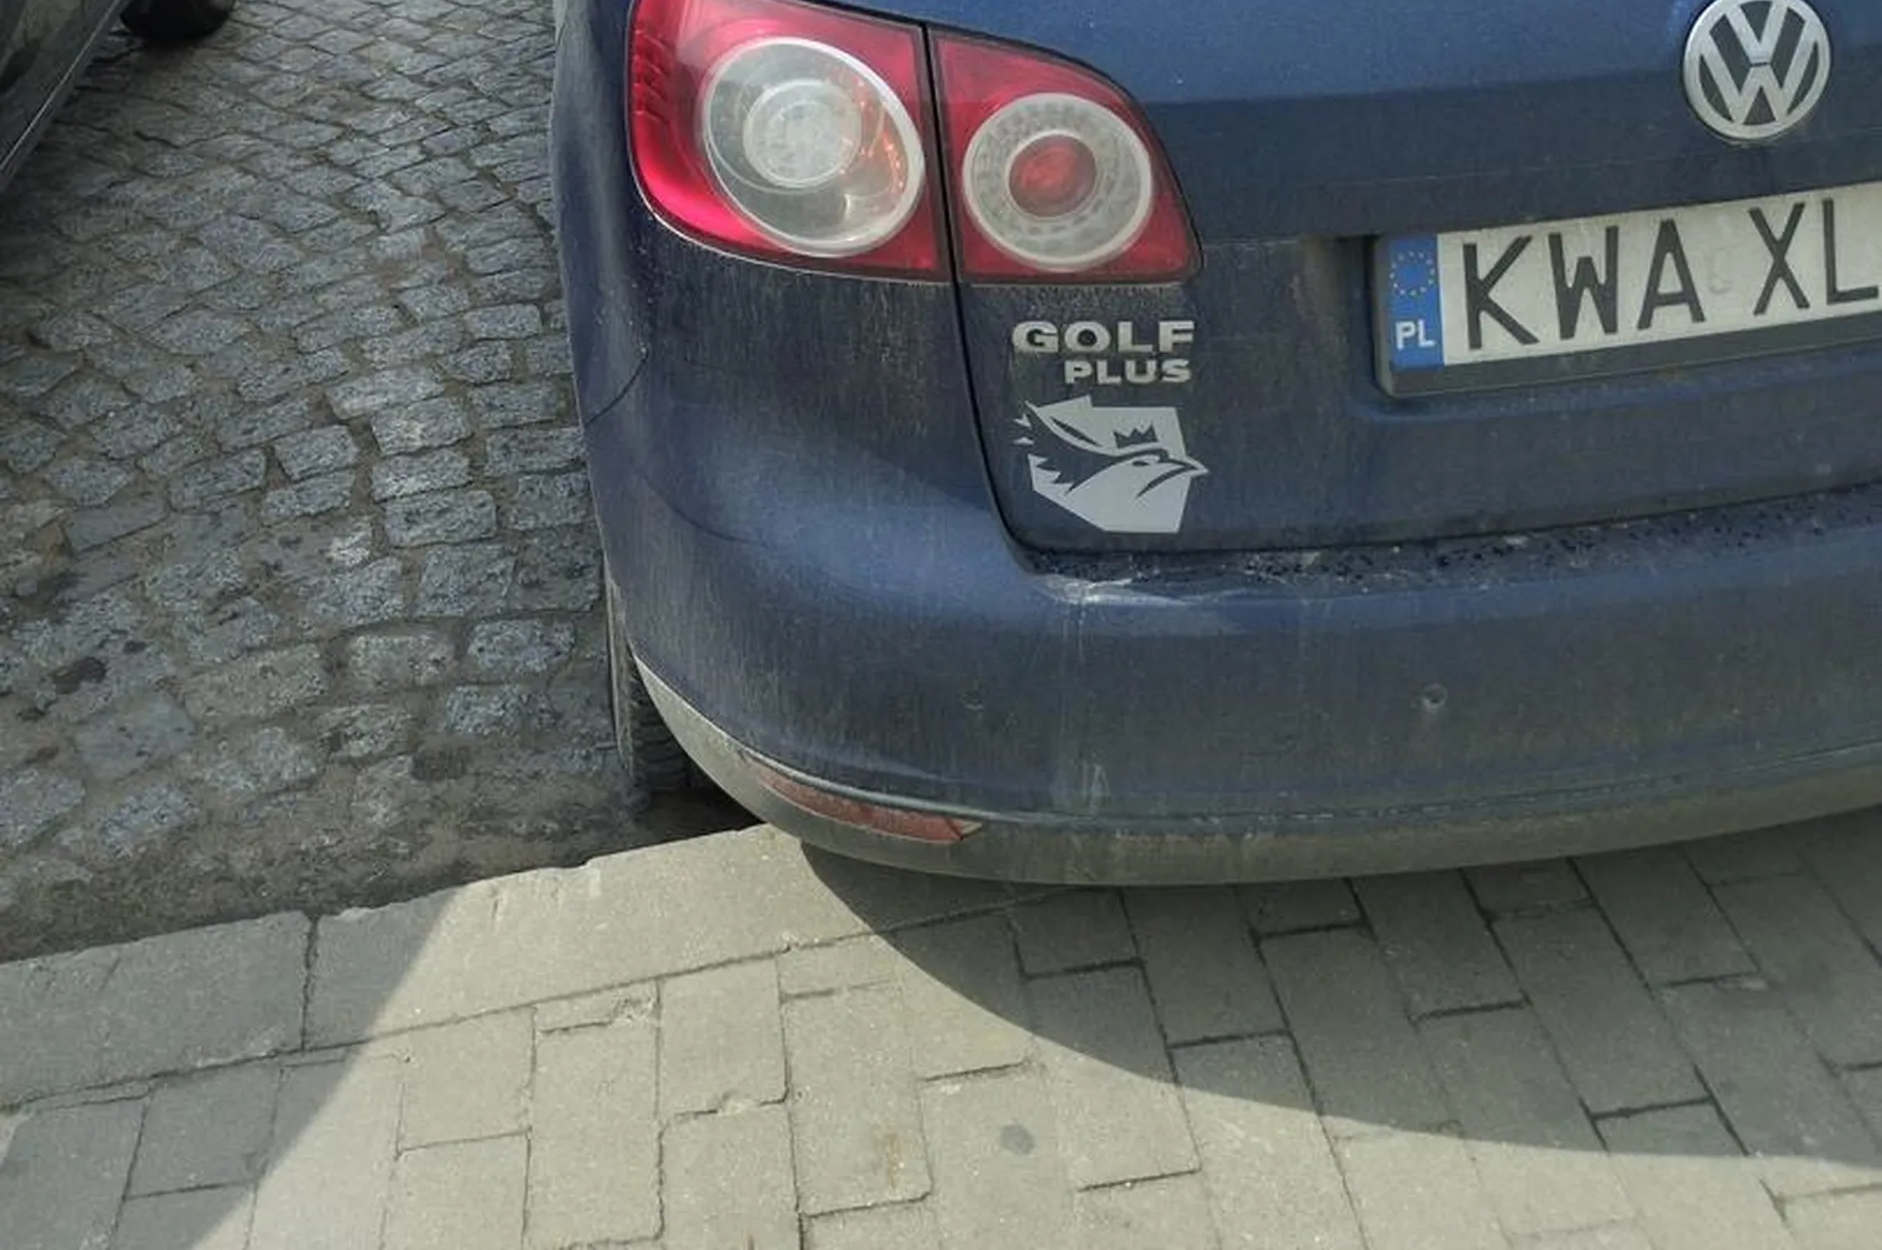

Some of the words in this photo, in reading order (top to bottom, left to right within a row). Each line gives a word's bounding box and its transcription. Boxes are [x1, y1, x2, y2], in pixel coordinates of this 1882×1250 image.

[1463, 219, 1706, 350] KWA
[1748, 198, 1880, 316] XL
[1011, 320, 1195, 353] GOLF
[1396, 321, 1435, 350] PL
[1064, 359, 1192, 385] PLUS
